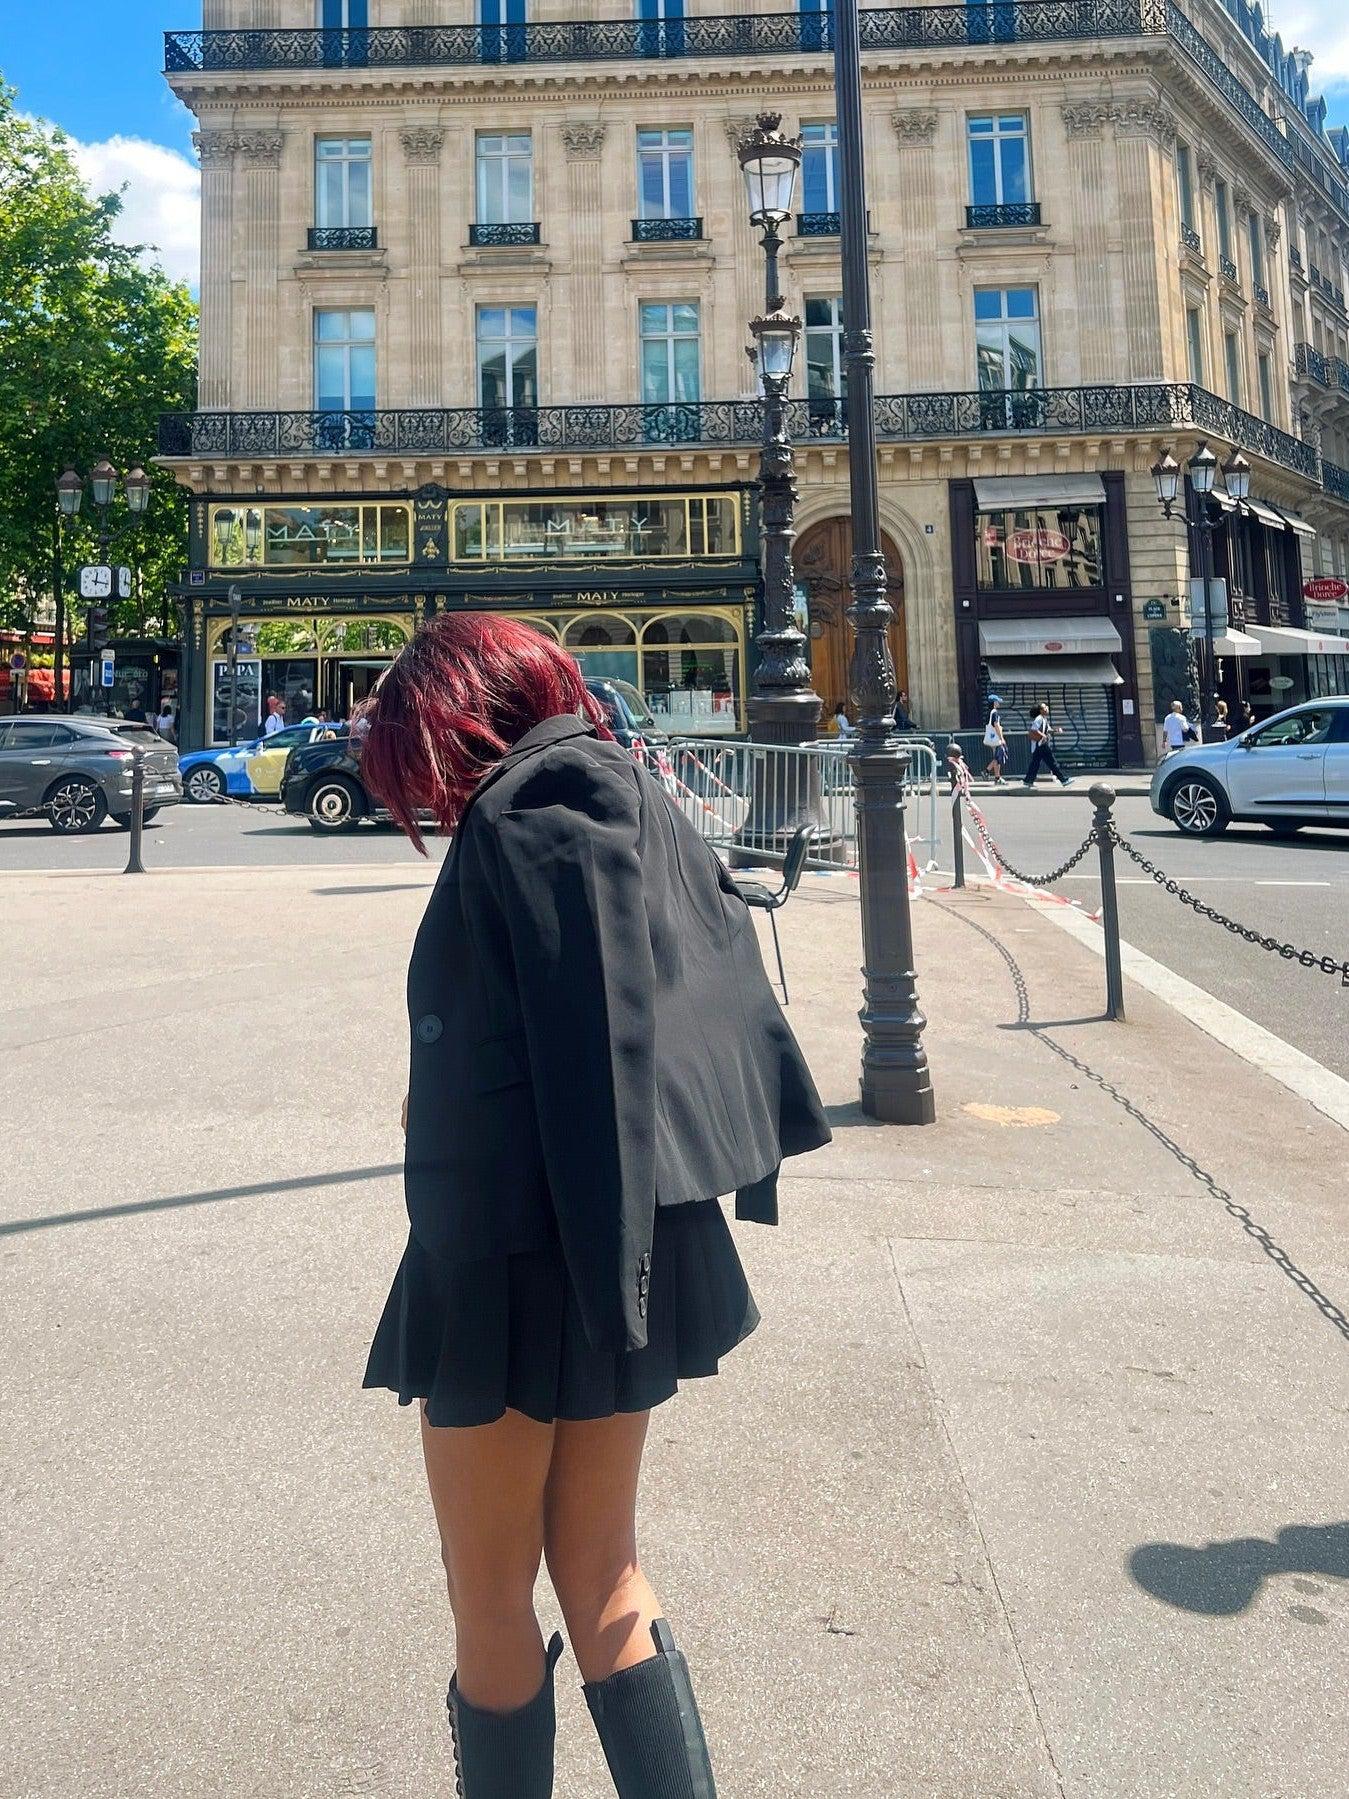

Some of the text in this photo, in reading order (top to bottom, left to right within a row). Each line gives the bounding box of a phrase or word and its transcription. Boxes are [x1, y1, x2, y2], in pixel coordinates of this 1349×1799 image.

[266, 523, 359, 540] MATY
[1309, 582, 1343, 592] Brioche
[577, 592, 619, 600] MATY
[287, 597, 330, 607] MATY
[219, 665, 254, 676] PPA
